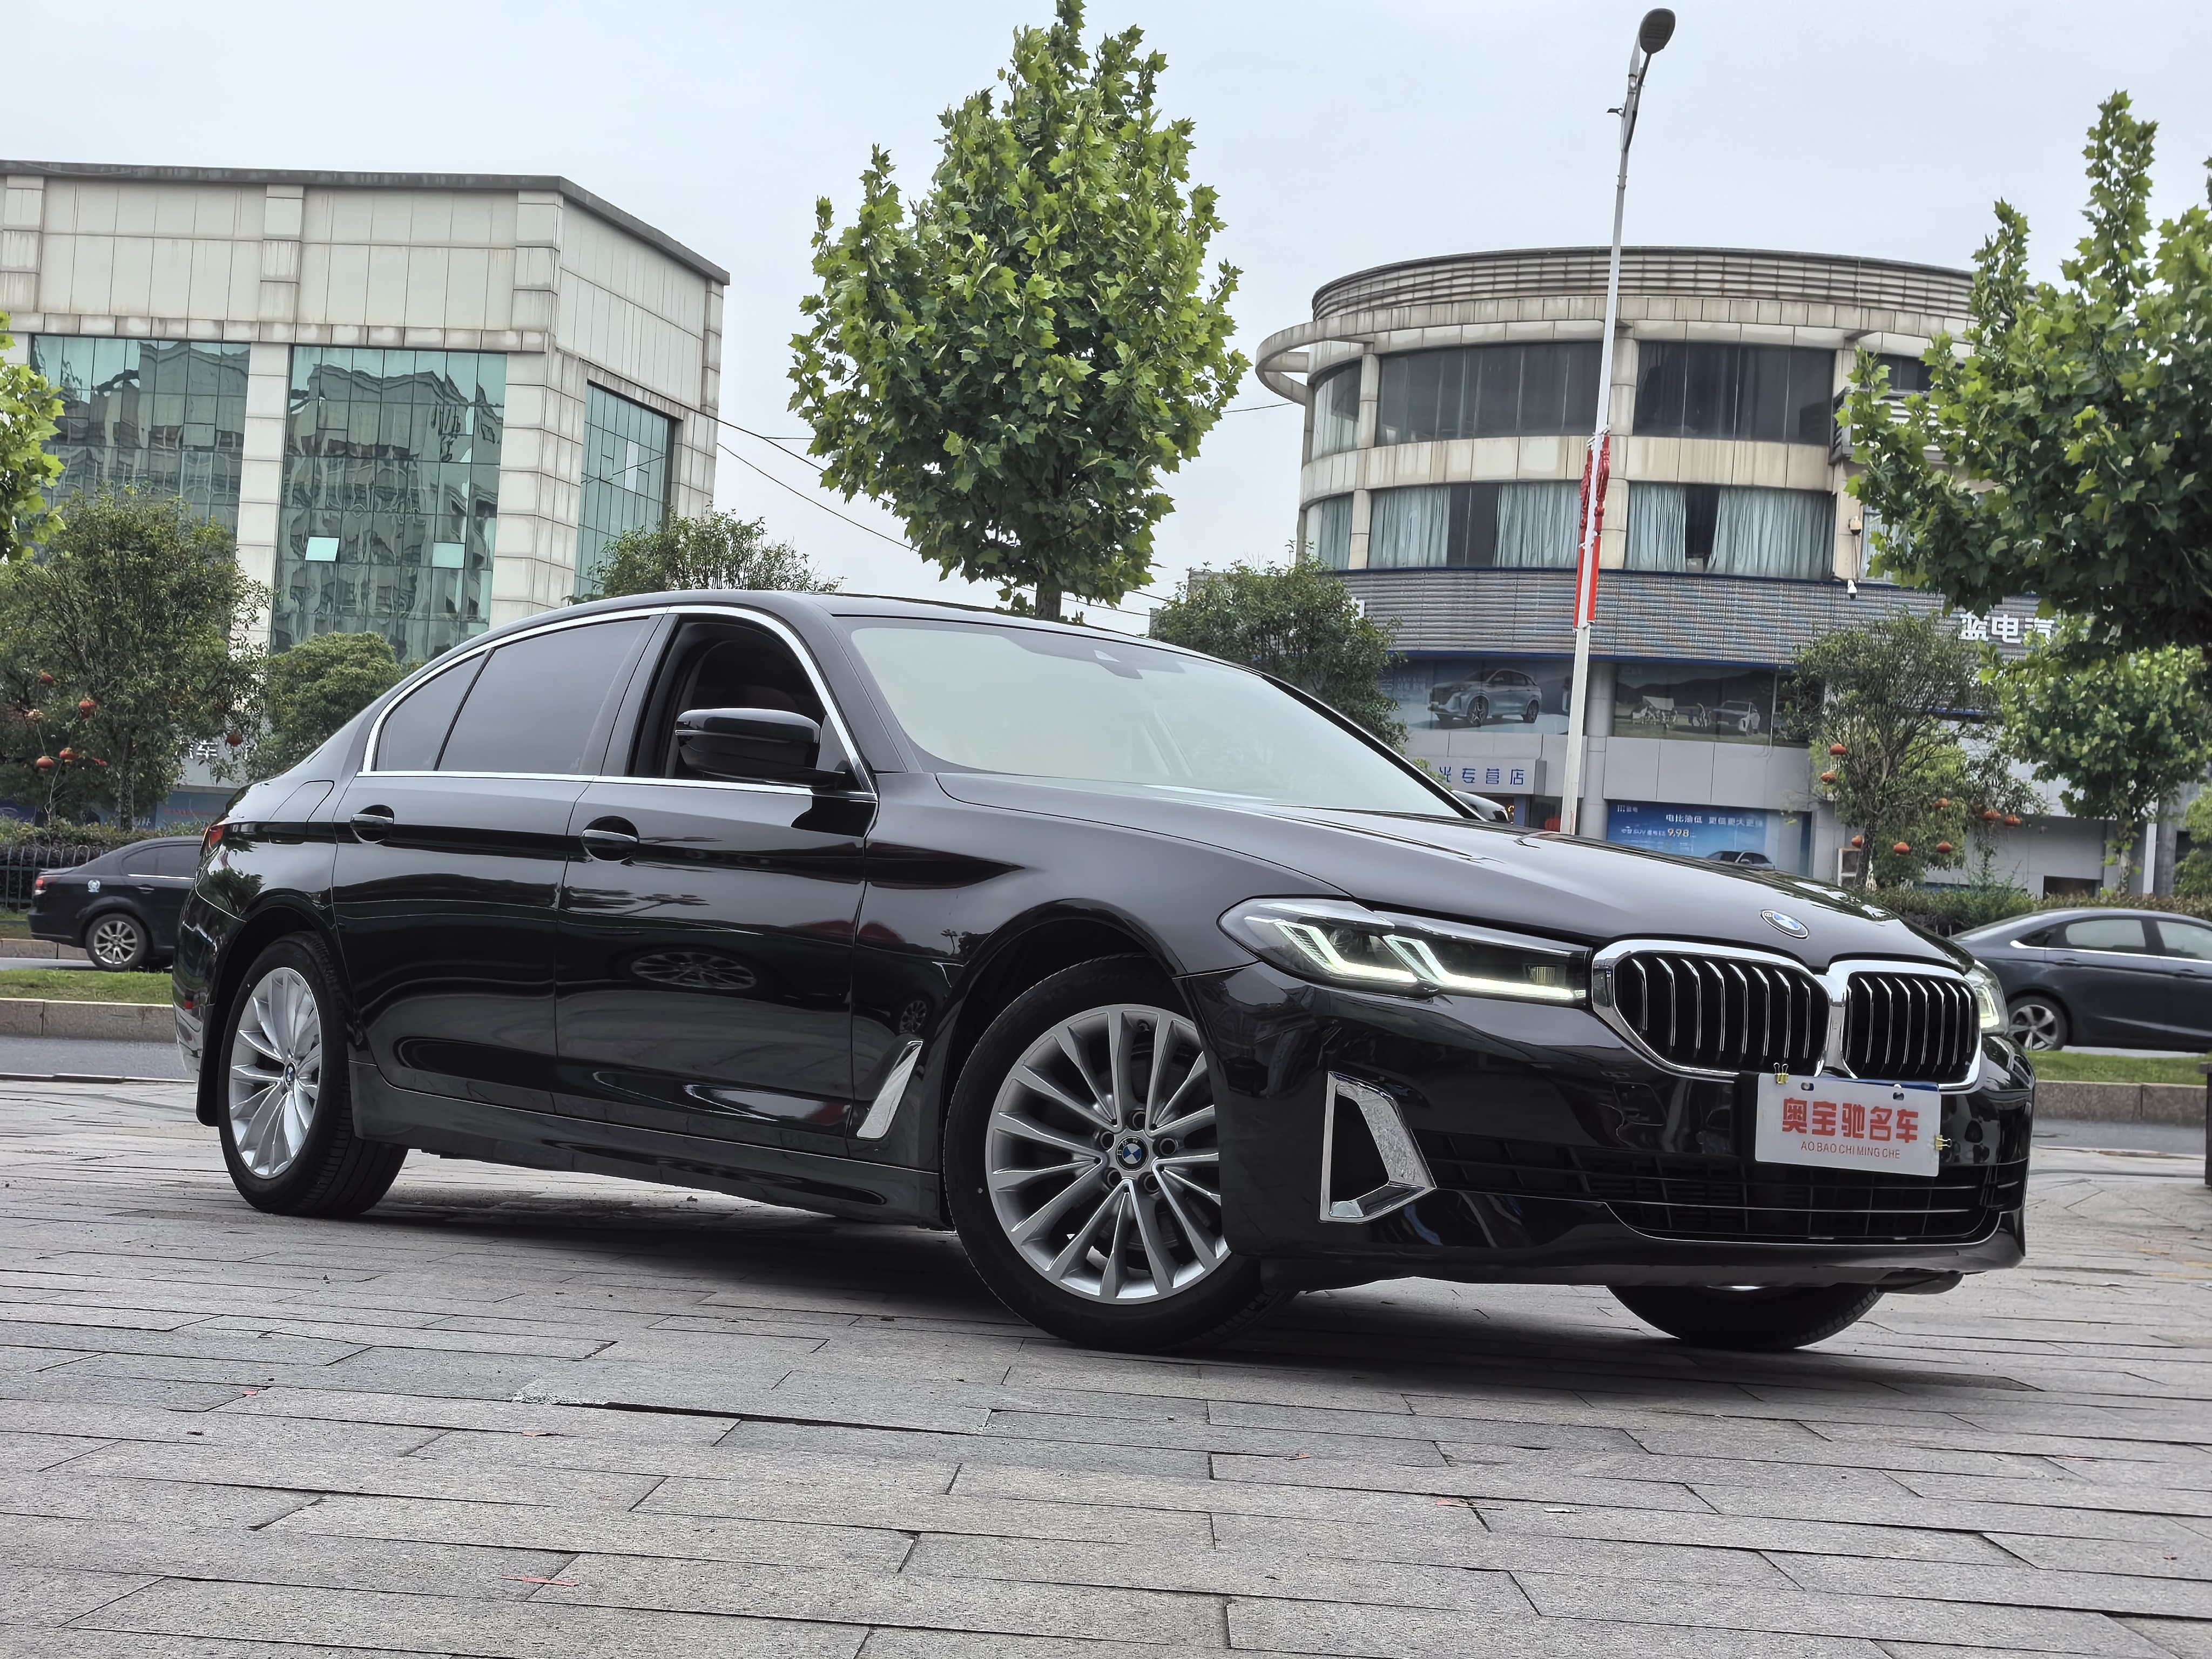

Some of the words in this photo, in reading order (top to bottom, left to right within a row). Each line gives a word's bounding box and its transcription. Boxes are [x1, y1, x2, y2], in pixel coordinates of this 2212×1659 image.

[1439, 766, 1524, 785] 光专营店
[1782, 1097, 1919, 1143] 奥宝驰名车
[1800, 1141, 1815, 1151] AO
[1817, 1143, 1837, 1153] BAO
[1839, 1144, 1855, 1155] CHI
[1857, 1146, 1880, 1157] MING
[1882, 1148, 1900, 1159] CHE
